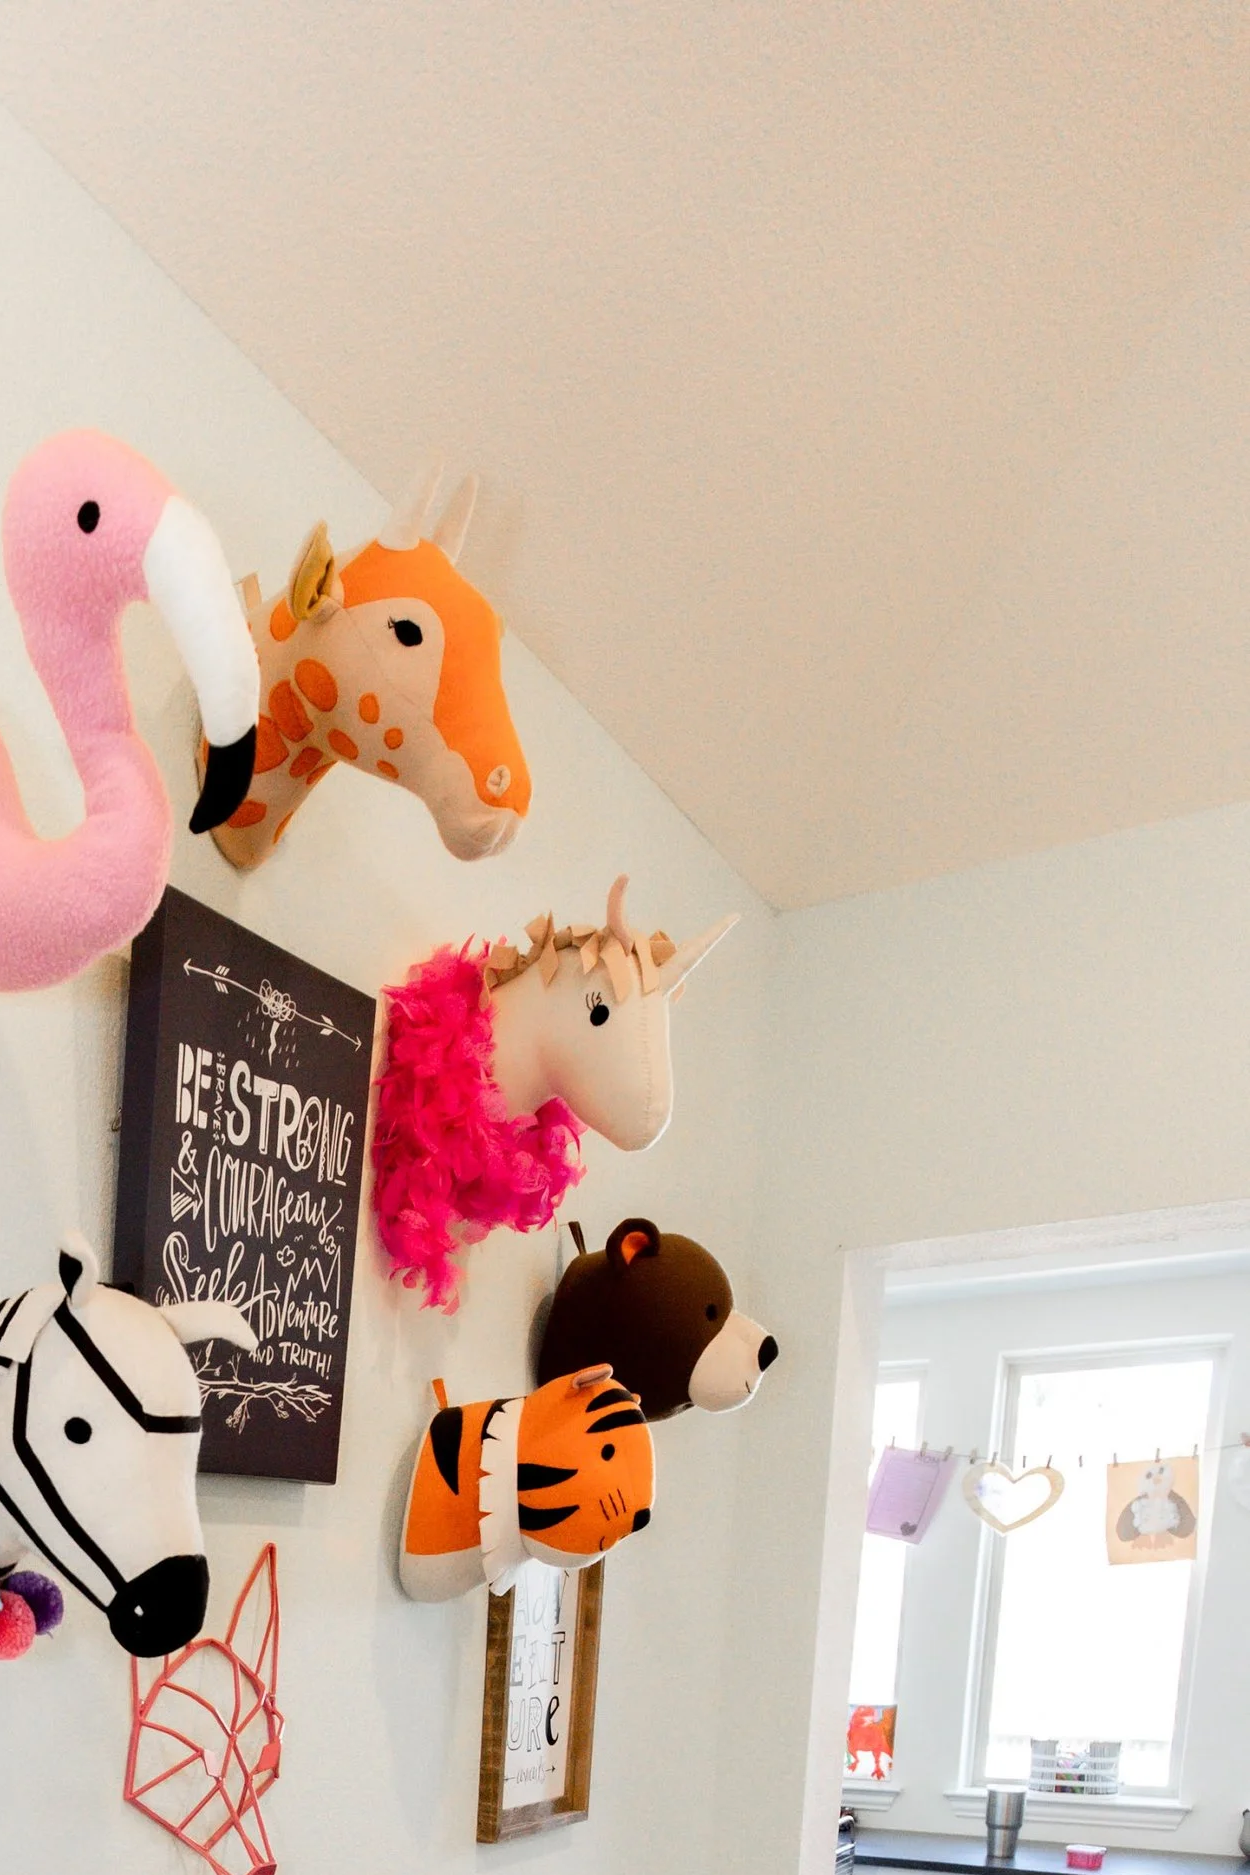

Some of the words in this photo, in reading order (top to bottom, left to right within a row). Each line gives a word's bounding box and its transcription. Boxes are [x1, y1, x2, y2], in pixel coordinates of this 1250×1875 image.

[176, 1042, 213, 1129] BE
[225, 1060, 355, 1187] STRONG
[178, 1130, 199, 1176] &
[162, 1231, 248, 1307] Seek
[278, 1341, 333, 1380] TRUTH!
